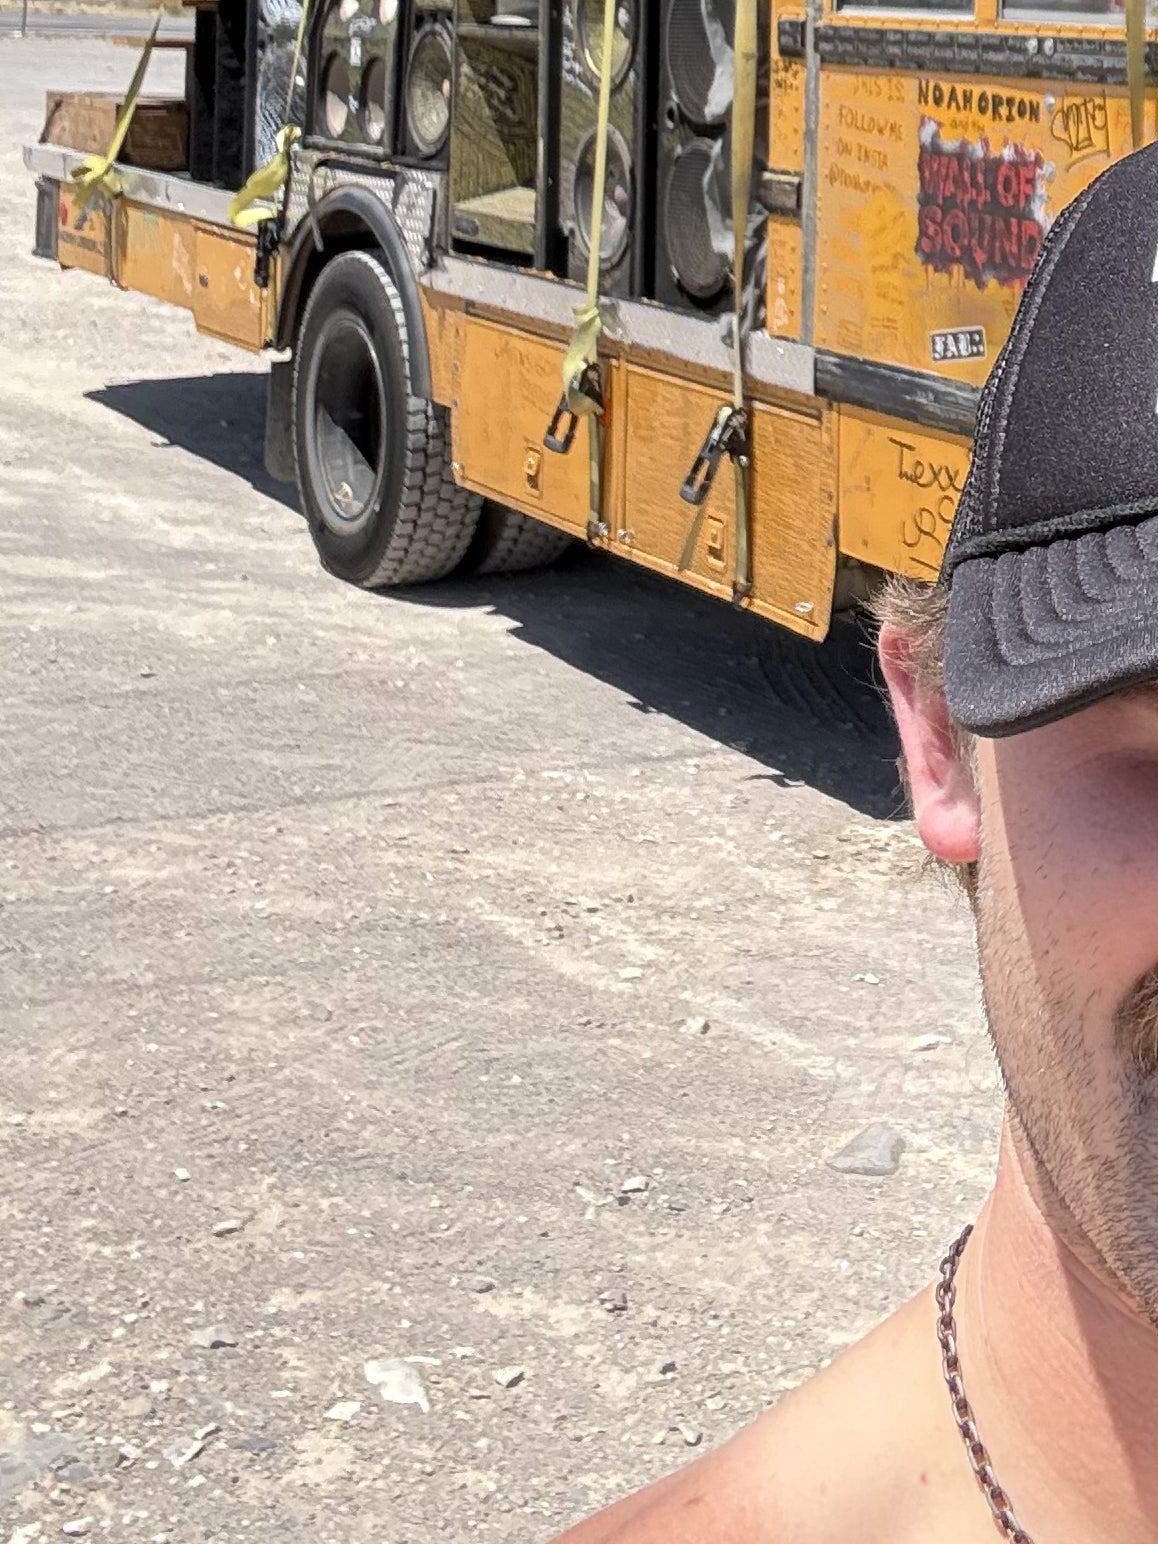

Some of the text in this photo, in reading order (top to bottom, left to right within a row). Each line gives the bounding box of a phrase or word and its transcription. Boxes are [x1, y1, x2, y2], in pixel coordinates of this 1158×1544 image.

[917, 77, 975, 112] NOAH
[977, 89, 1040, 124] ORION
[920, 152, 992, 211] WALL
[996, 162, 1036, 210] OF
[918, 204, 1043, 271] SOUND
